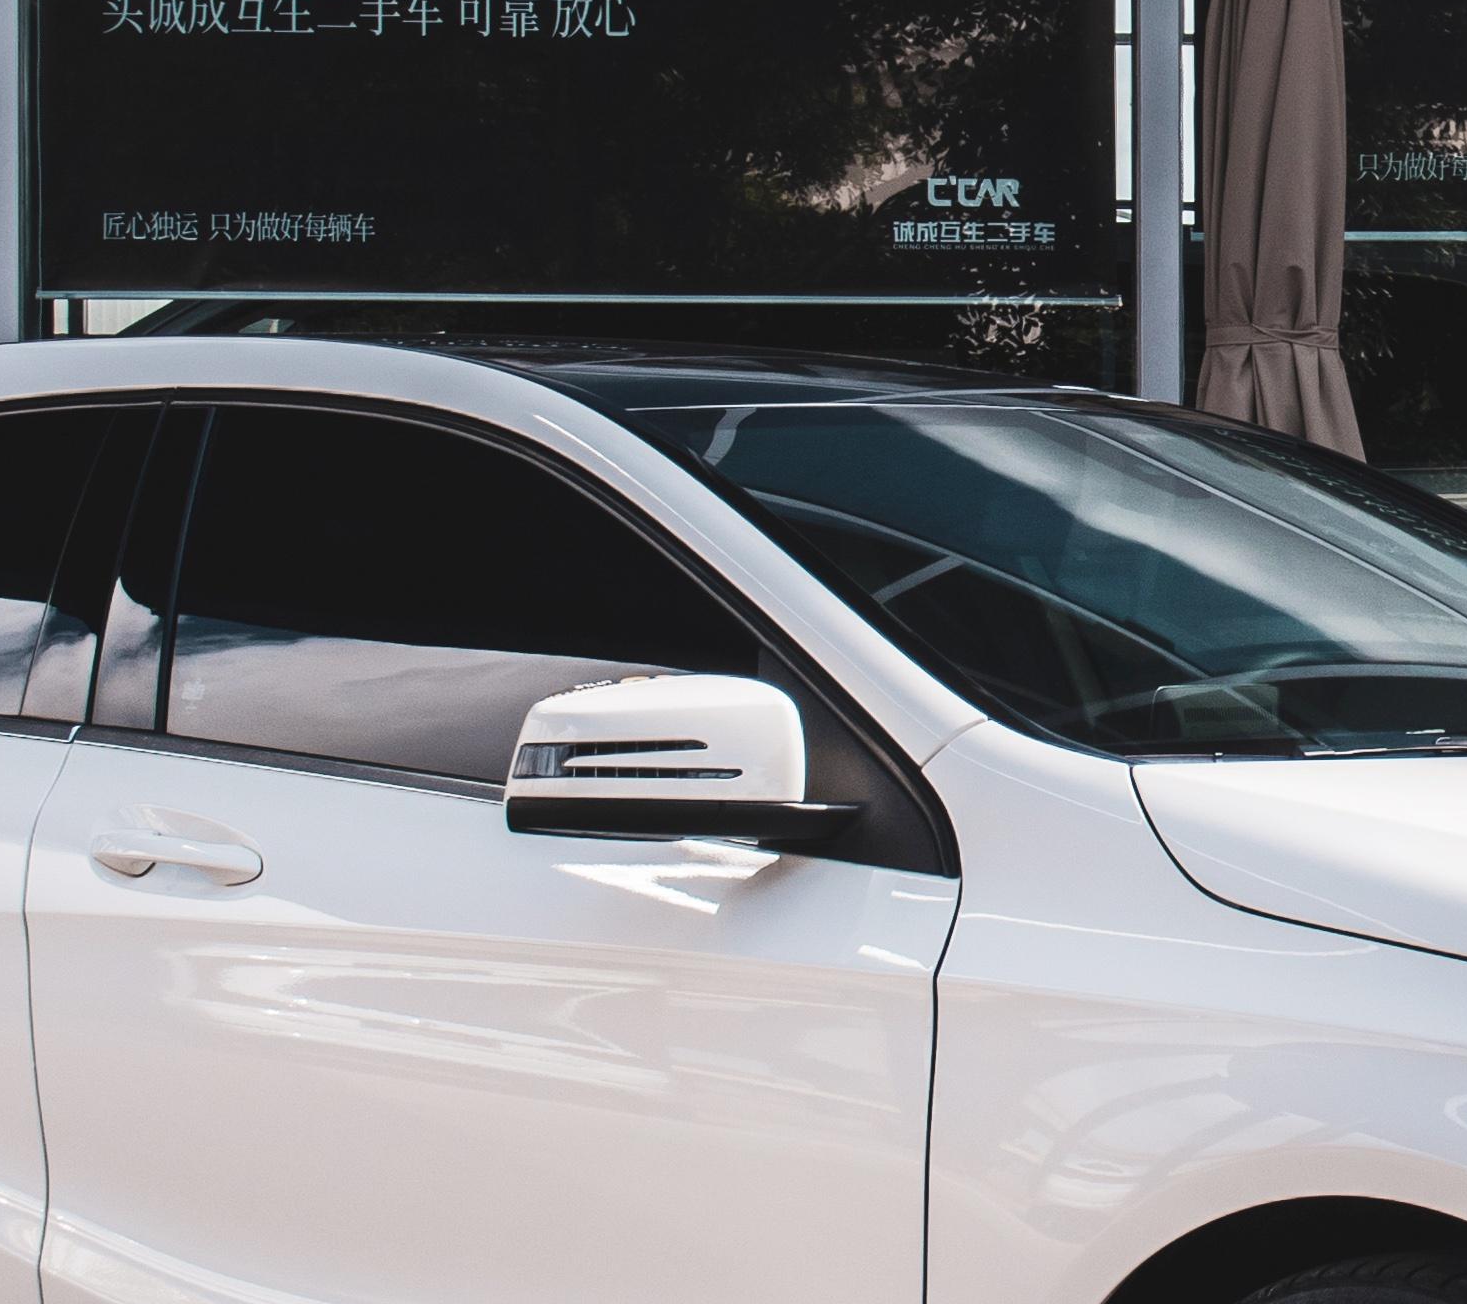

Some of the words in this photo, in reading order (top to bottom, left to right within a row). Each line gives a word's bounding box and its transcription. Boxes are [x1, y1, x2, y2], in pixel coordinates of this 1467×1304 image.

[102, 211, 199, 241] 匠心独运
[208, 211, 376, 243] 只为做好每辆车
[893, 221, 1056, 244] 诚成互生二手车
